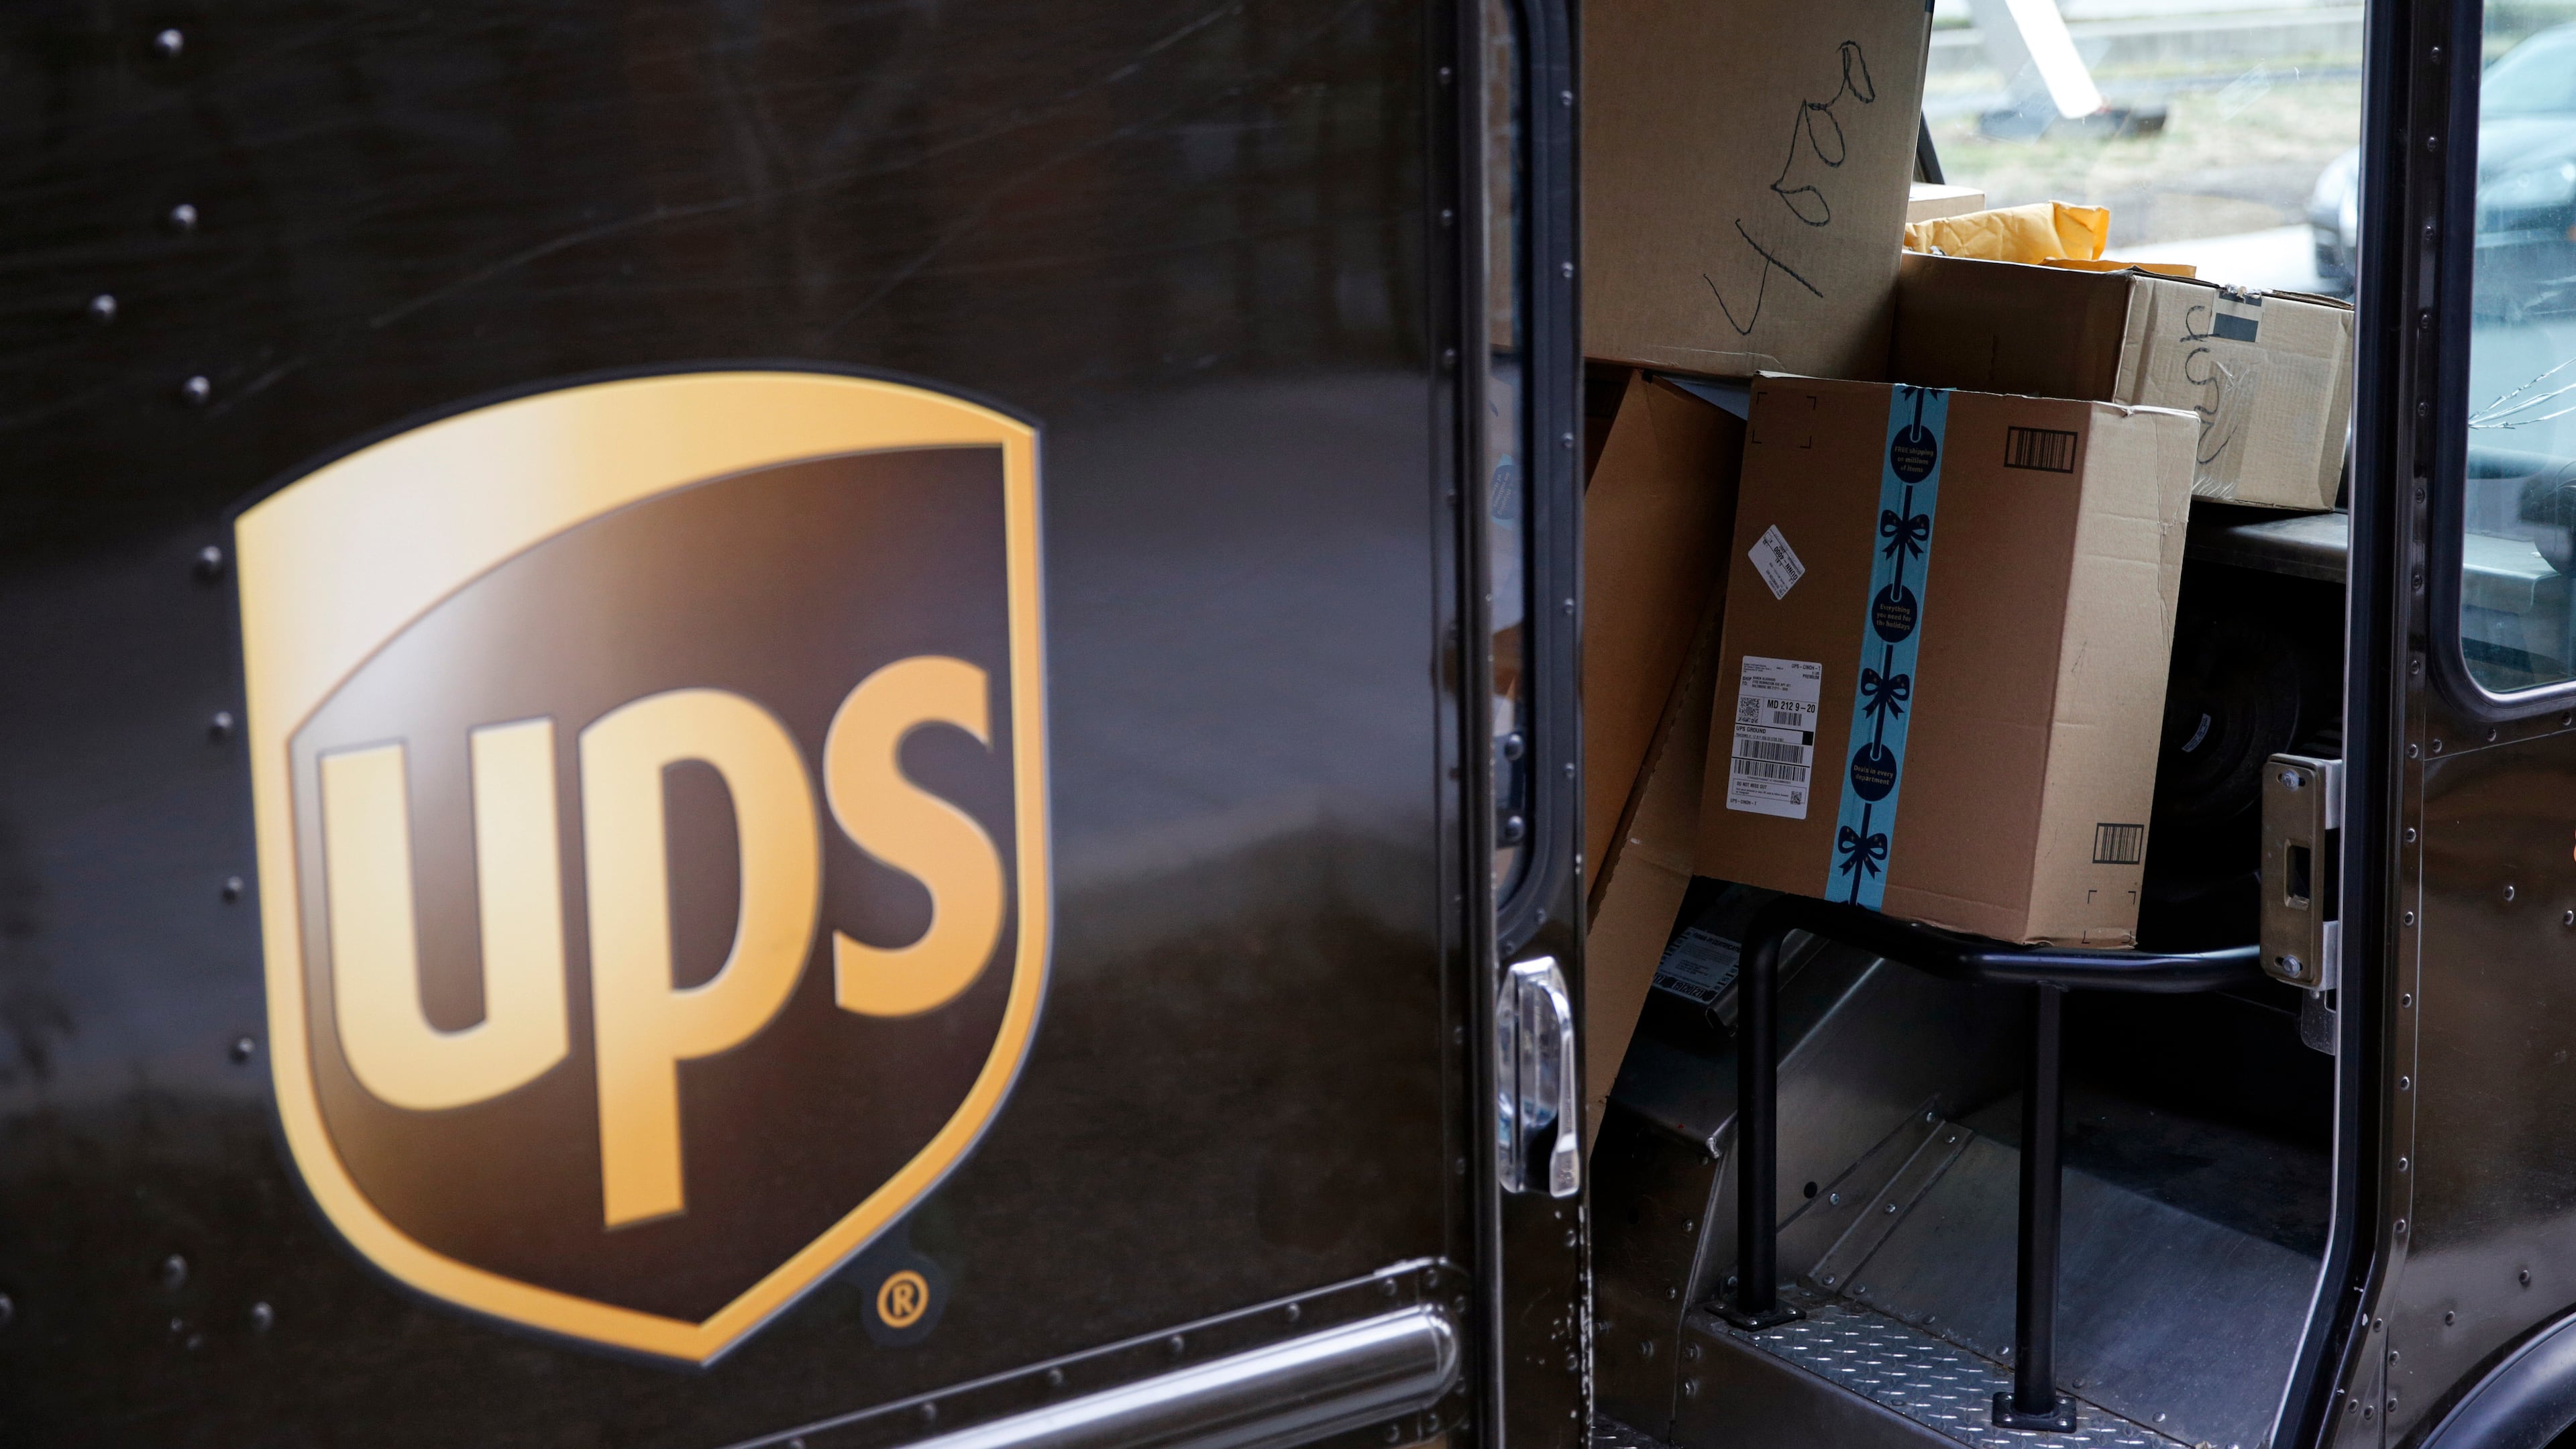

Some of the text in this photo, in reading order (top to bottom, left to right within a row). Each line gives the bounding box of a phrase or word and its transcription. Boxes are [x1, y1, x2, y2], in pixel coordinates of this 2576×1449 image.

[1910, 447, 1933, 457] shipping
[1880, 603, 1911, 614] Everything
[1886, 621, 1911, 631] holidays
[1767, 700, 1778, 708] MD
[1780, 701, 1792, 710] 212
[1854, 765, 1870, 773] Deals
[1877, 769, 1894, 778] every
[1856, 774, 1889, 785] department
[319, 654, 1007, 1230] ups
